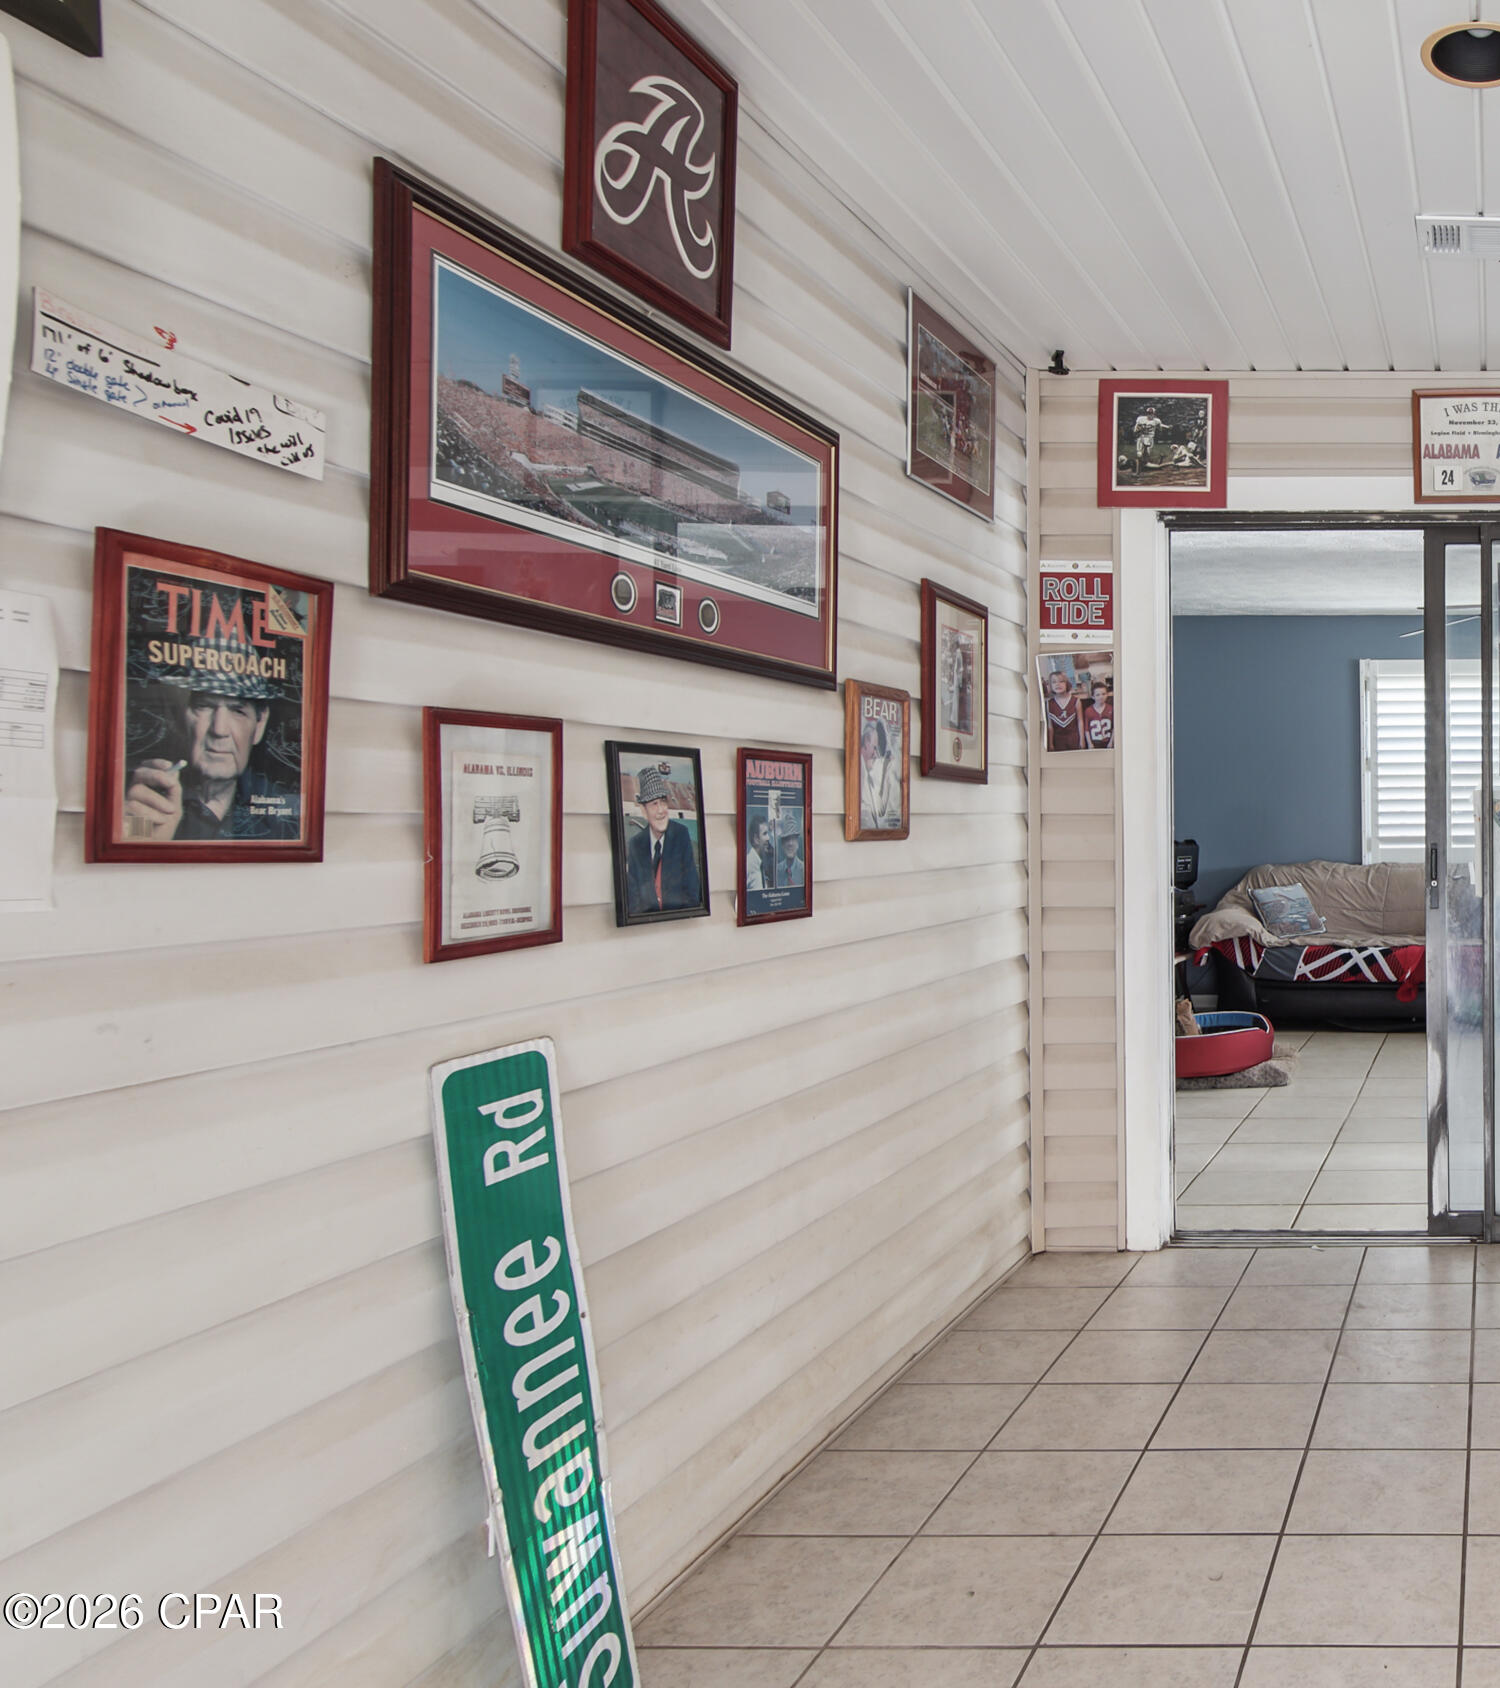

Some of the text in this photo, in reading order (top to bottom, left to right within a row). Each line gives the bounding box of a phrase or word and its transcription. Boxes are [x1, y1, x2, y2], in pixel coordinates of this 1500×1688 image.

[1452, 402, 1478, 414] WAS
[1423, 443, 1480, 460] ALABAMA
[1441, 470, 1455, 486] 24
[1043, 577, 1110, 601] ROLL
[156, 578, 277, 648] TIME
[1045, 601, 1105, 625] TIDE
[148, 640, 287, 679] SUPERCOACH
[864, 697, 898, 722] BEAR
[1089, 719, 1112, 741] 22
[463, 763, 494, 776] ALABAMA
[506, 764, 533, 778] ILLINOIS
[745, 759, 803, 781] AUBURN
[250, 806, 268, 816] Bear
[477, 1088, 549, 1187] Rd
